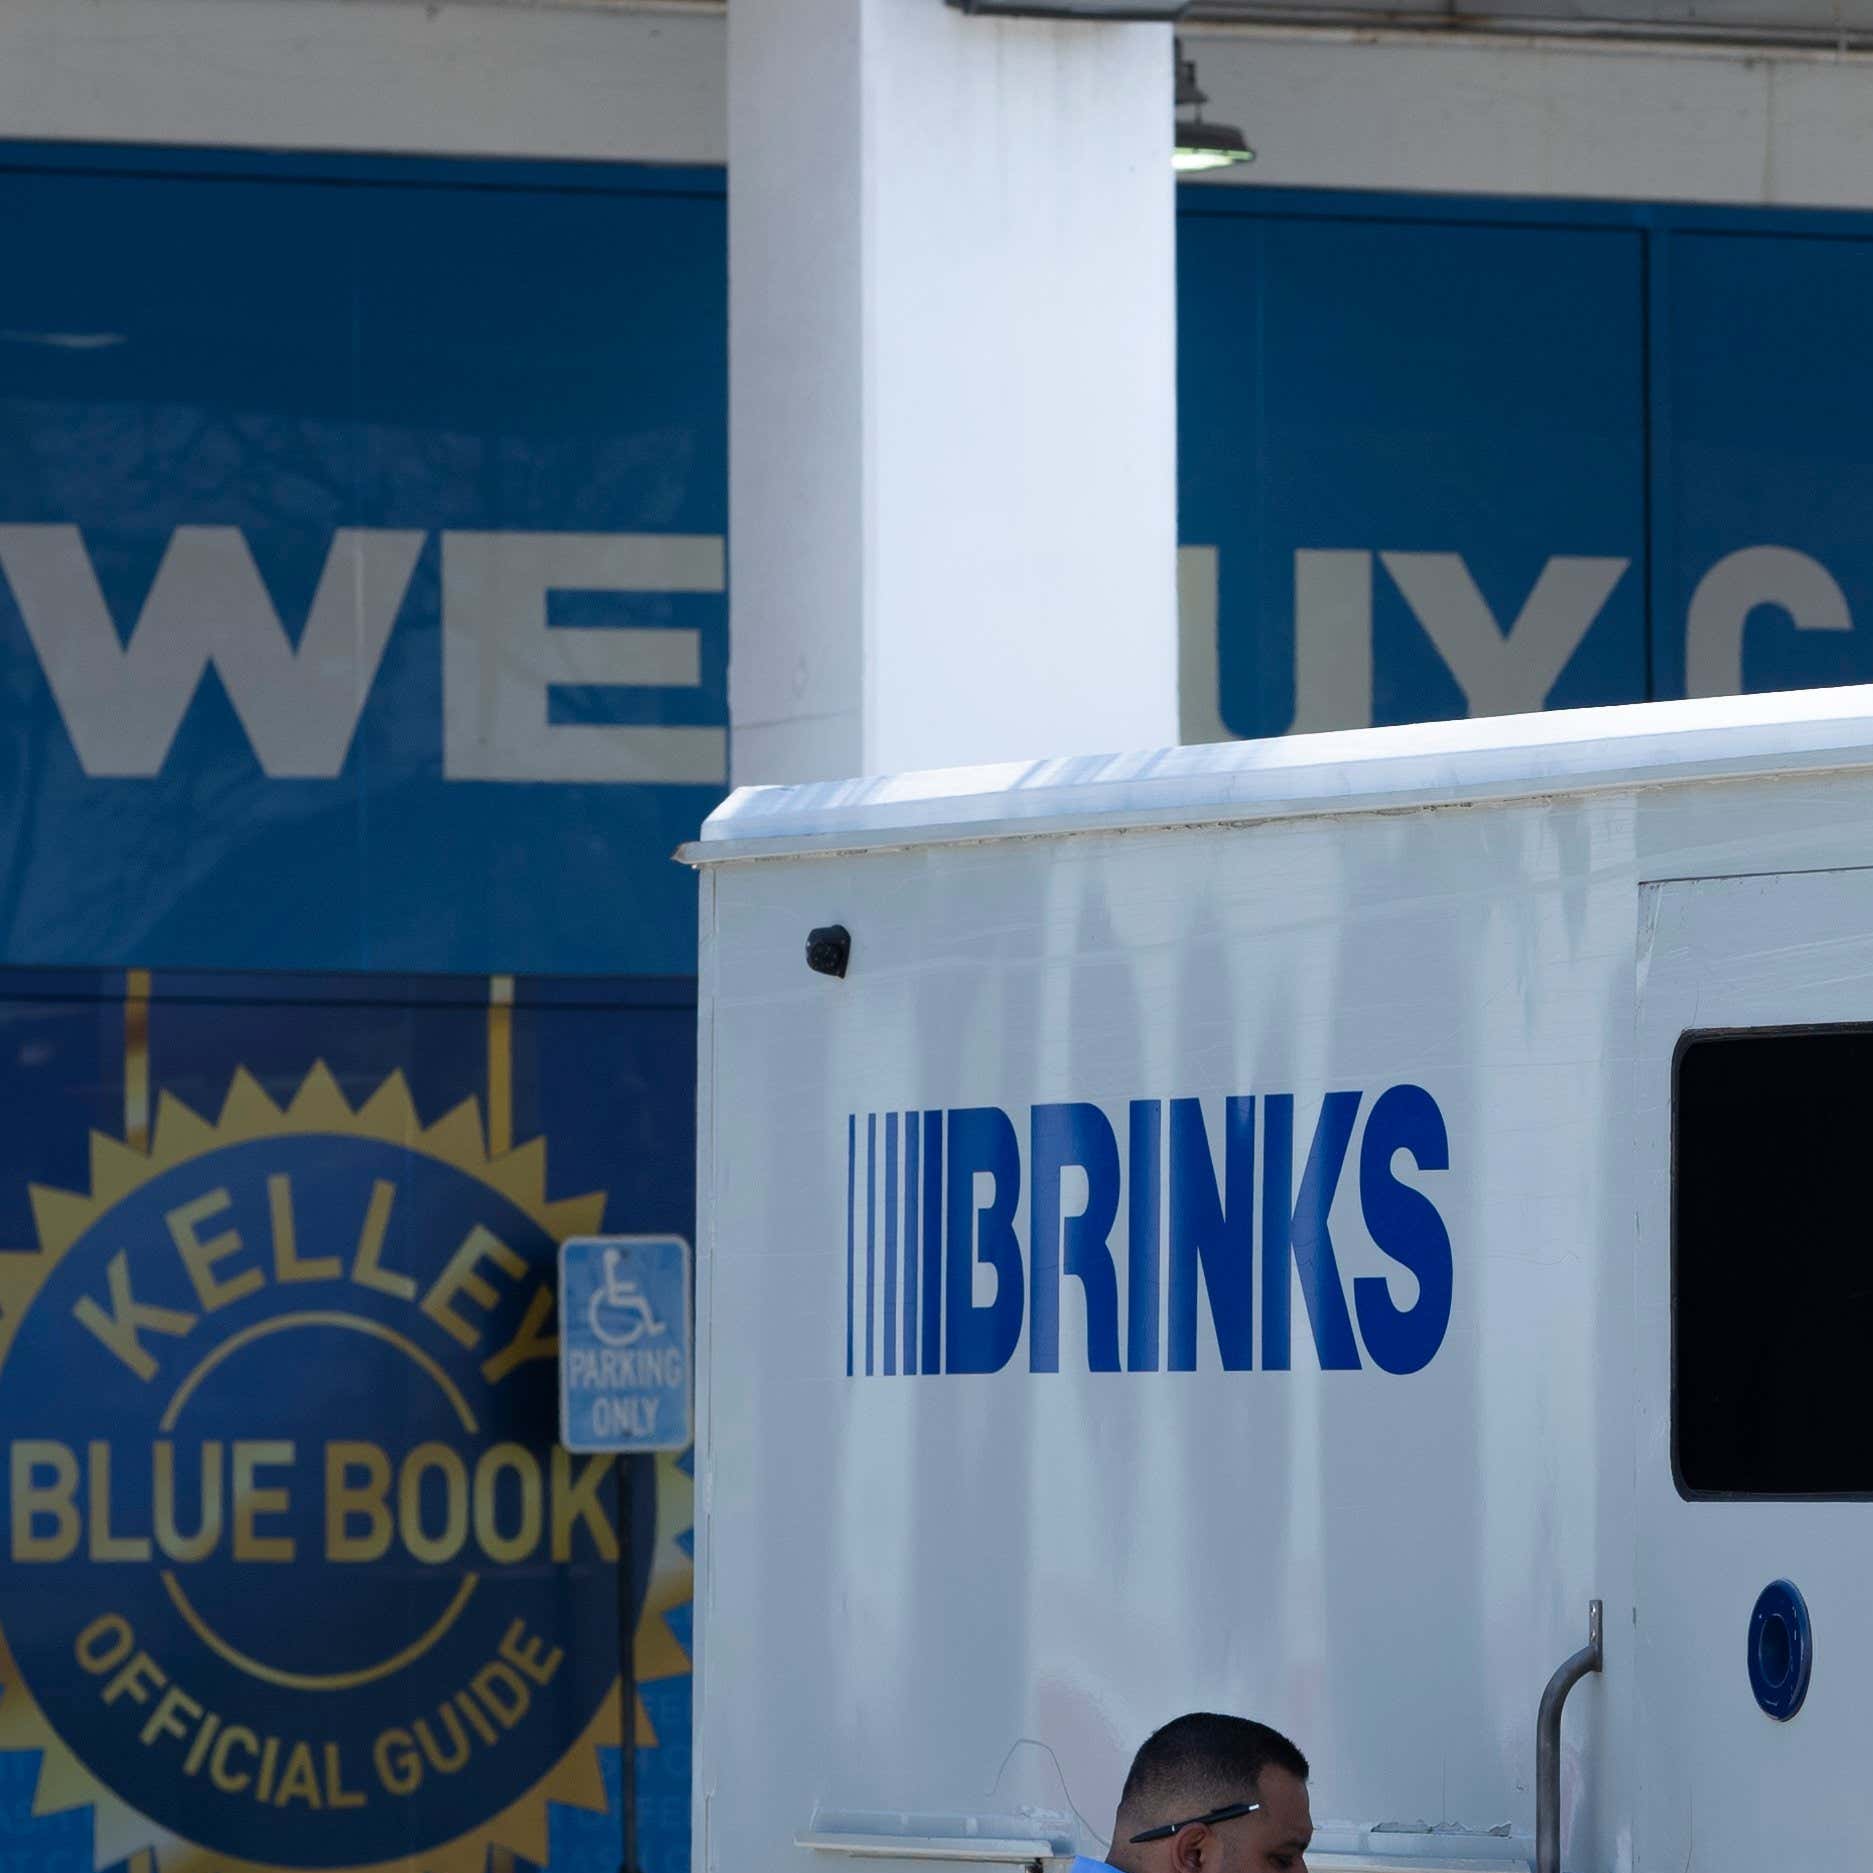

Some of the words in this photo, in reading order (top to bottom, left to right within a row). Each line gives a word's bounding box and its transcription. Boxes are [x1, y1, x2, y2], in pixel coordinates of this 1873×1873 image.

[0, 524, 728, 784] WE
[1176, 546, 1631, 742] UY
[72, 1173, 561, 1385] KELLEY
[945, 1084, 1454, 1376] BRINKS
[569, 1349, 682, 1389] PARKING
[592, 1396, 660, 1438] ONLY
[10, 1440, 296, 1563] BLUE
[324, 1440, 621, 1563] BOOK
[74, 1611, 367, 1811] OFFICIAL
[373, 1617, 565, 1796] GUIDE
